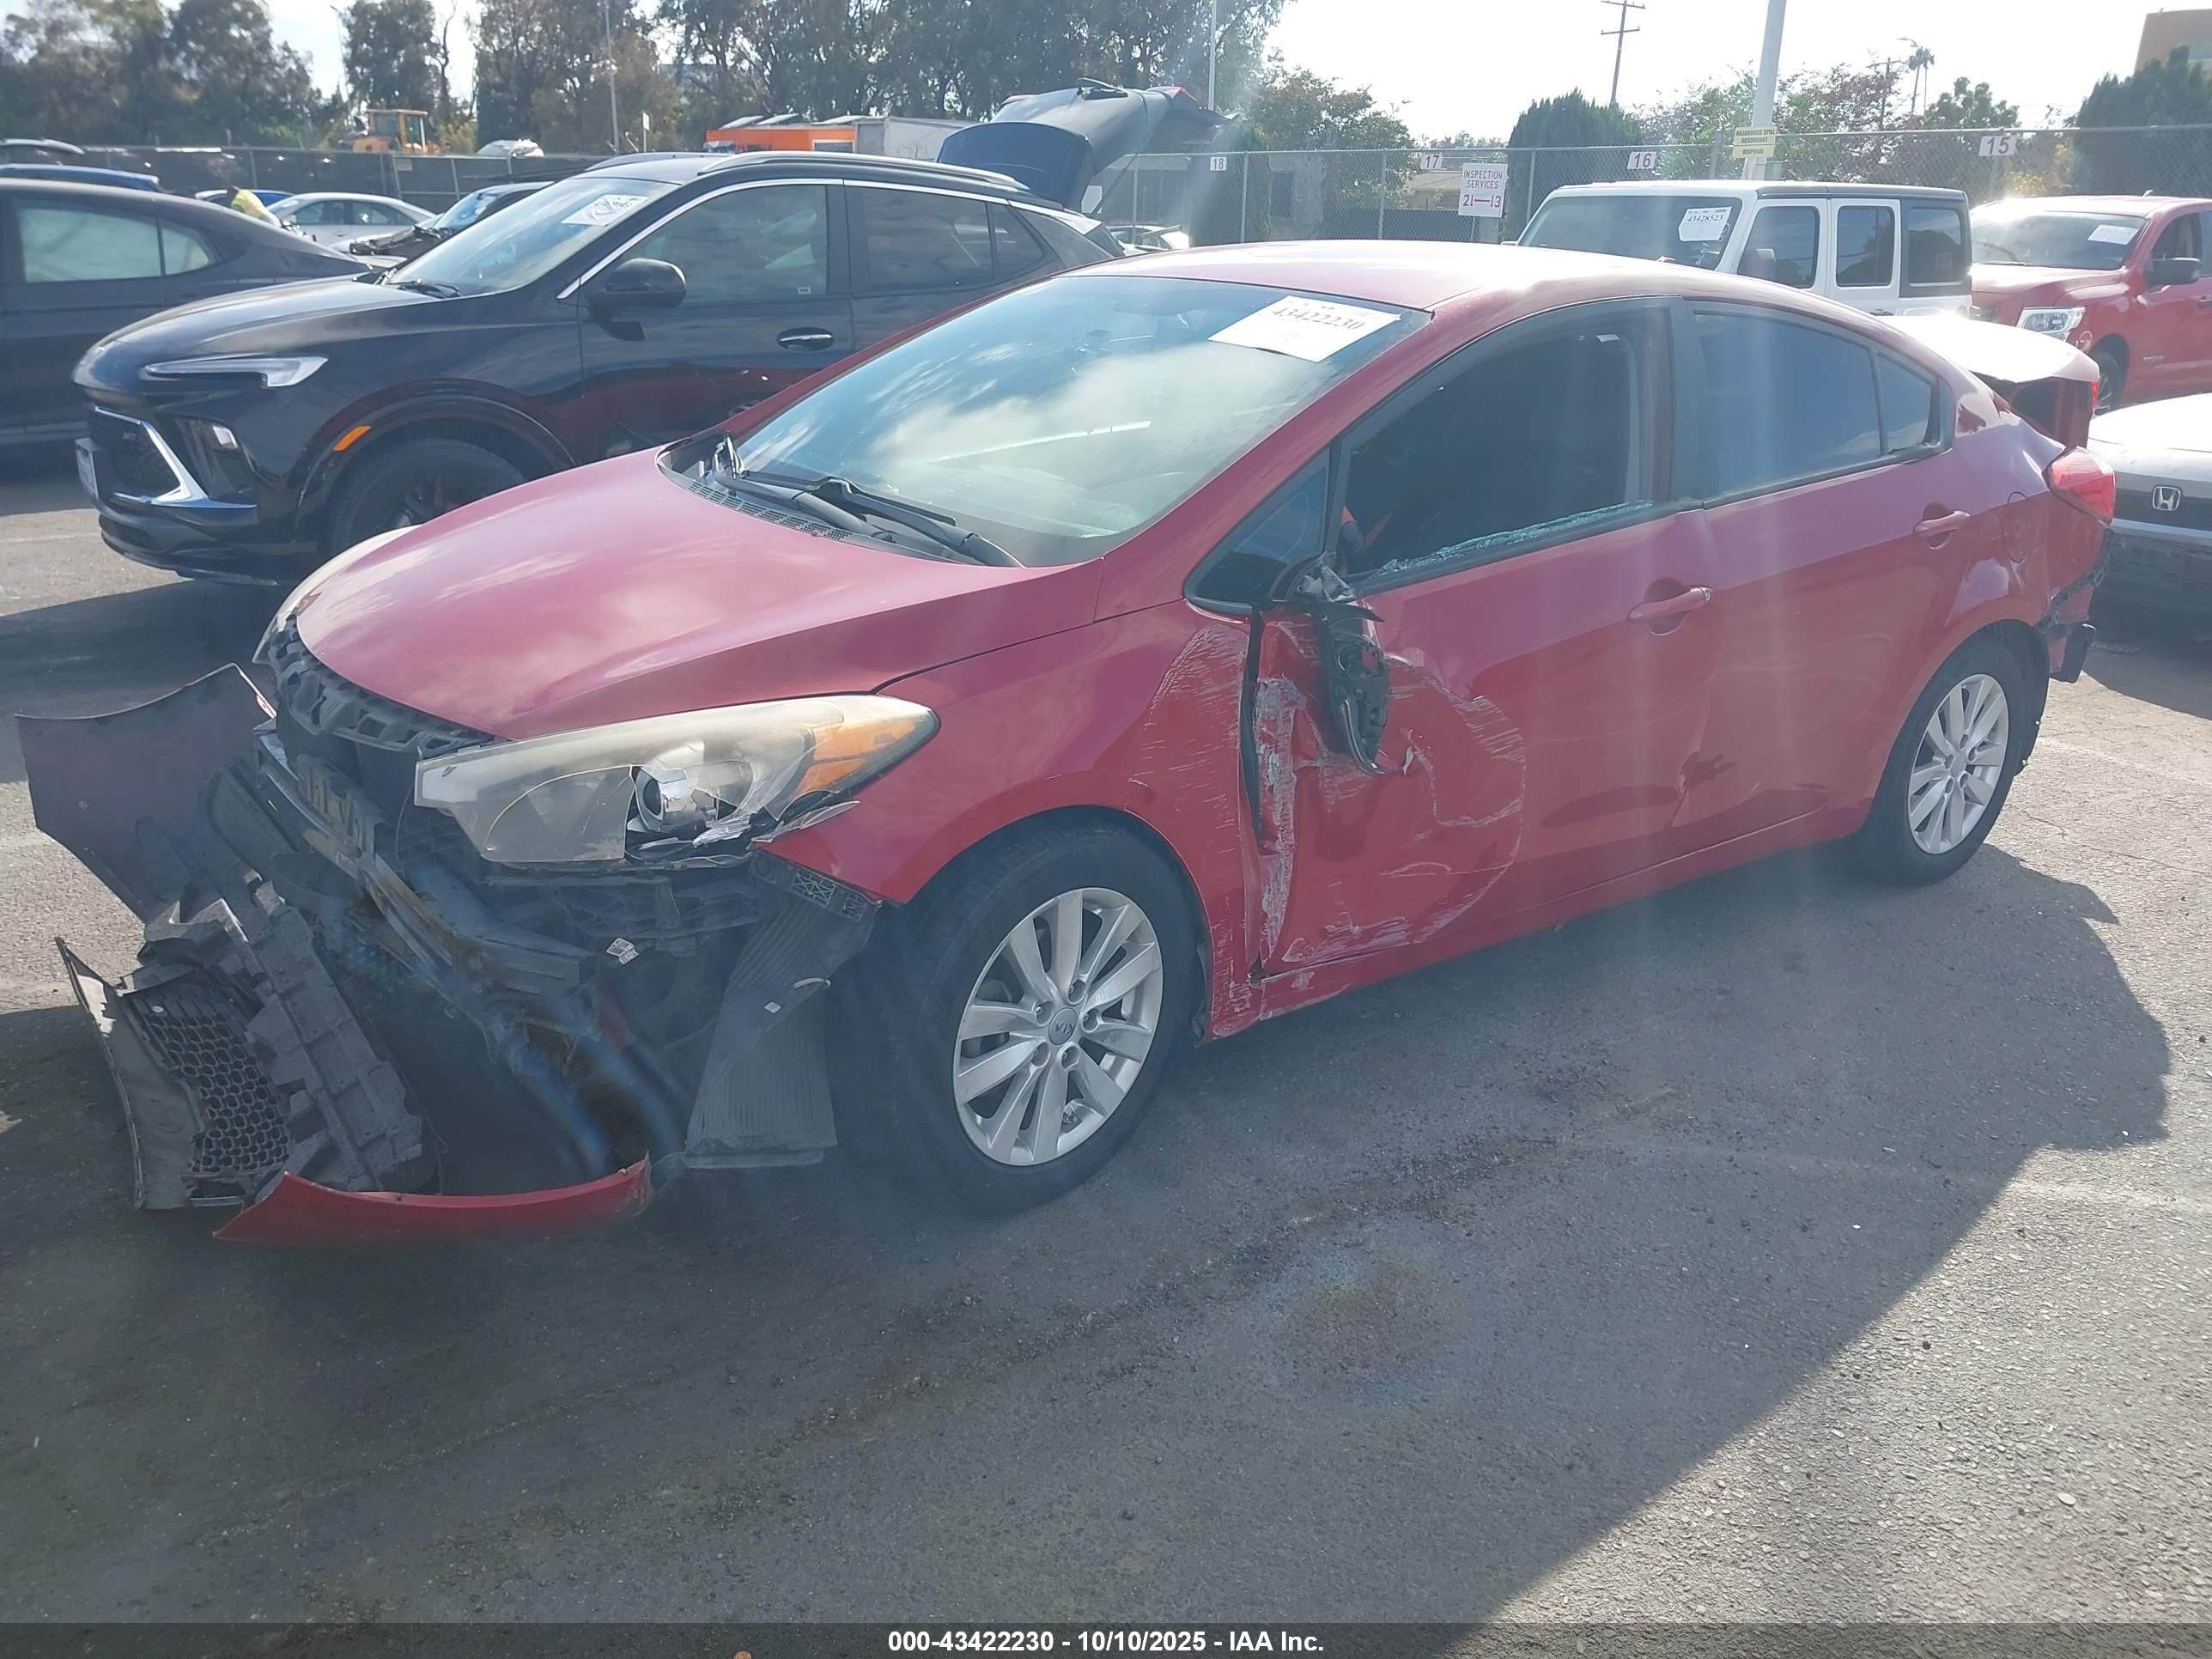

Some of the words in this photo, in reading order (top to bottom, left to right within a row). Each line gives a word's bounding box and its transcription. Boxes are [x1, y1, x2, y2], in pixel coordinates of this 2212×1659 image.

[1986, 137, 2009, 155] 15
[1213, 157, 1224, 170] 18
[1425, 155, 1440, 168] 17
[1633, 153, 1651, 168] 16
[1463, 170, 1503, 179] INSPECTION
[1467, 179, 1499, 189] SERVICES
[1271, 307, 1366, 331] 43422230
[1055, 1023, 1076, 1036] KIA
